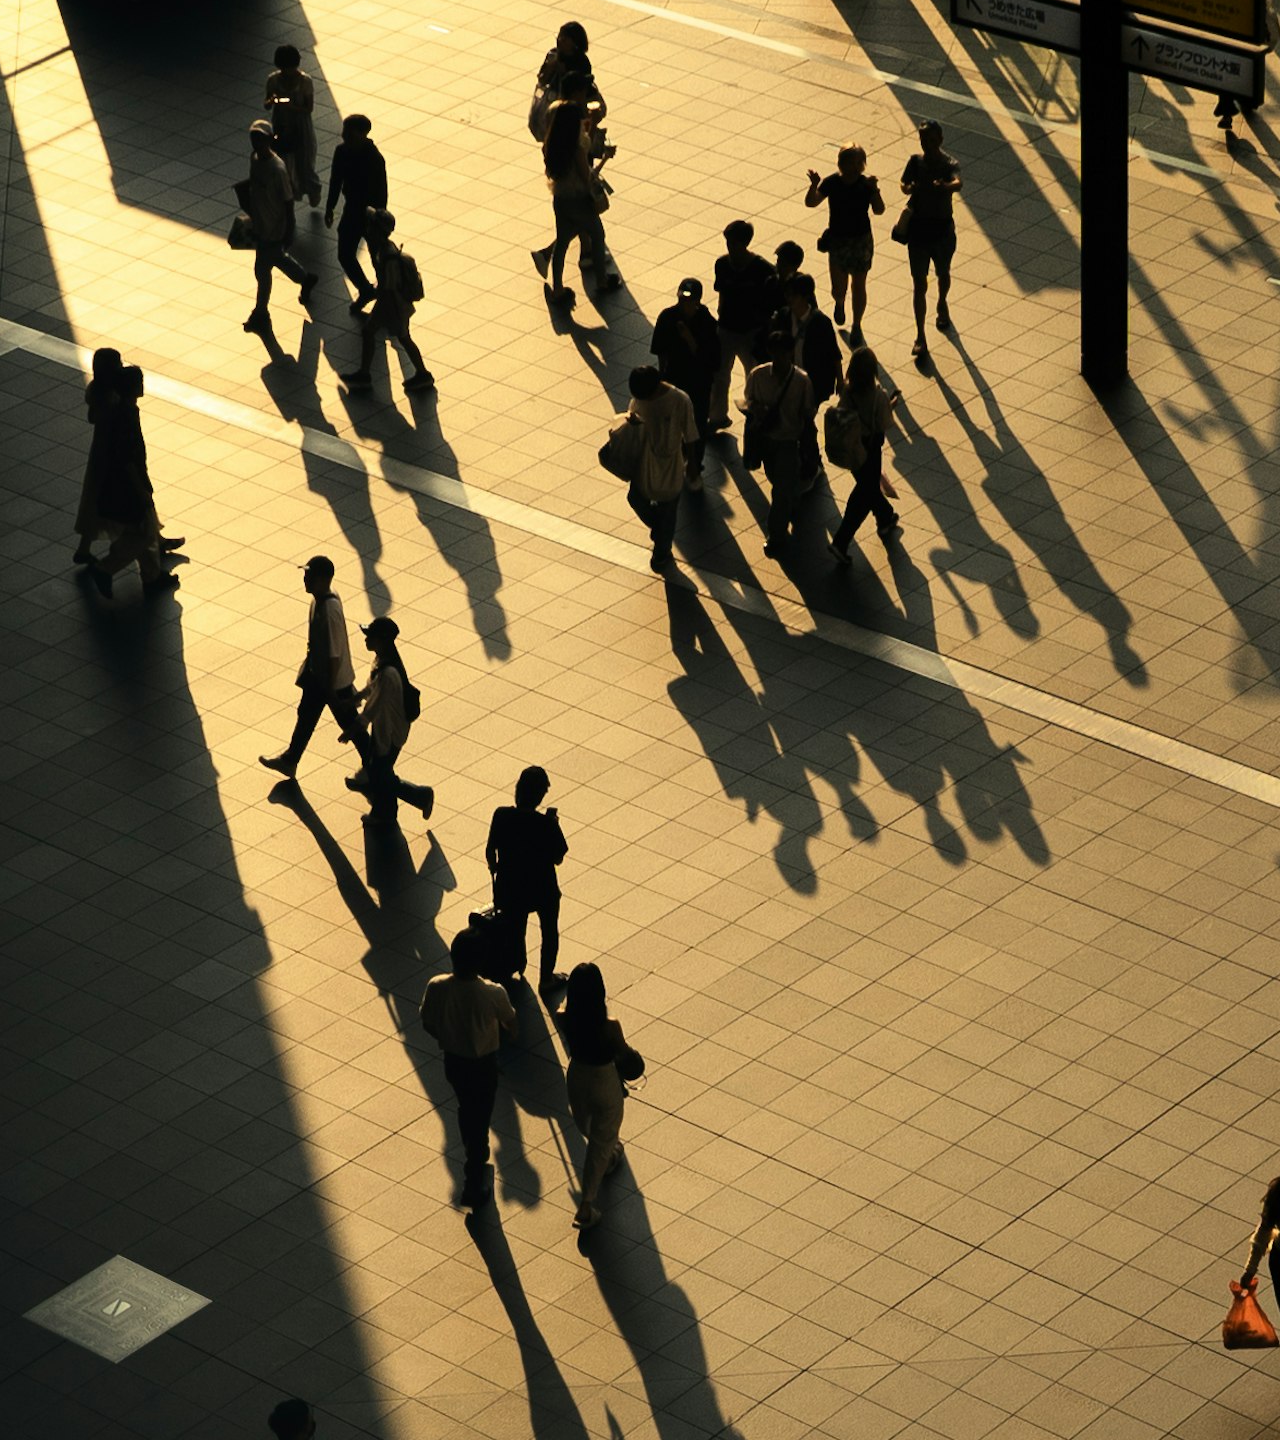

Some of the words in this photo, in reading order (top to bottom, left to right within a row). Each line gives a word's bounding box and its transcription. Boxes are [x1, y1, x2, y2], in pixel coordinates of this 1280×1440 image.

[988, 10, 1018, 25] Umekita
[1019, 18, 1038, 31] Plaza
[1154, 55, 1178, 70] Grand
[1179, 62, 1199, 74] Front
[1200, 68, 1224, 82] Osaka
[1155, 41, 1241, 77] グランフロント大阪
